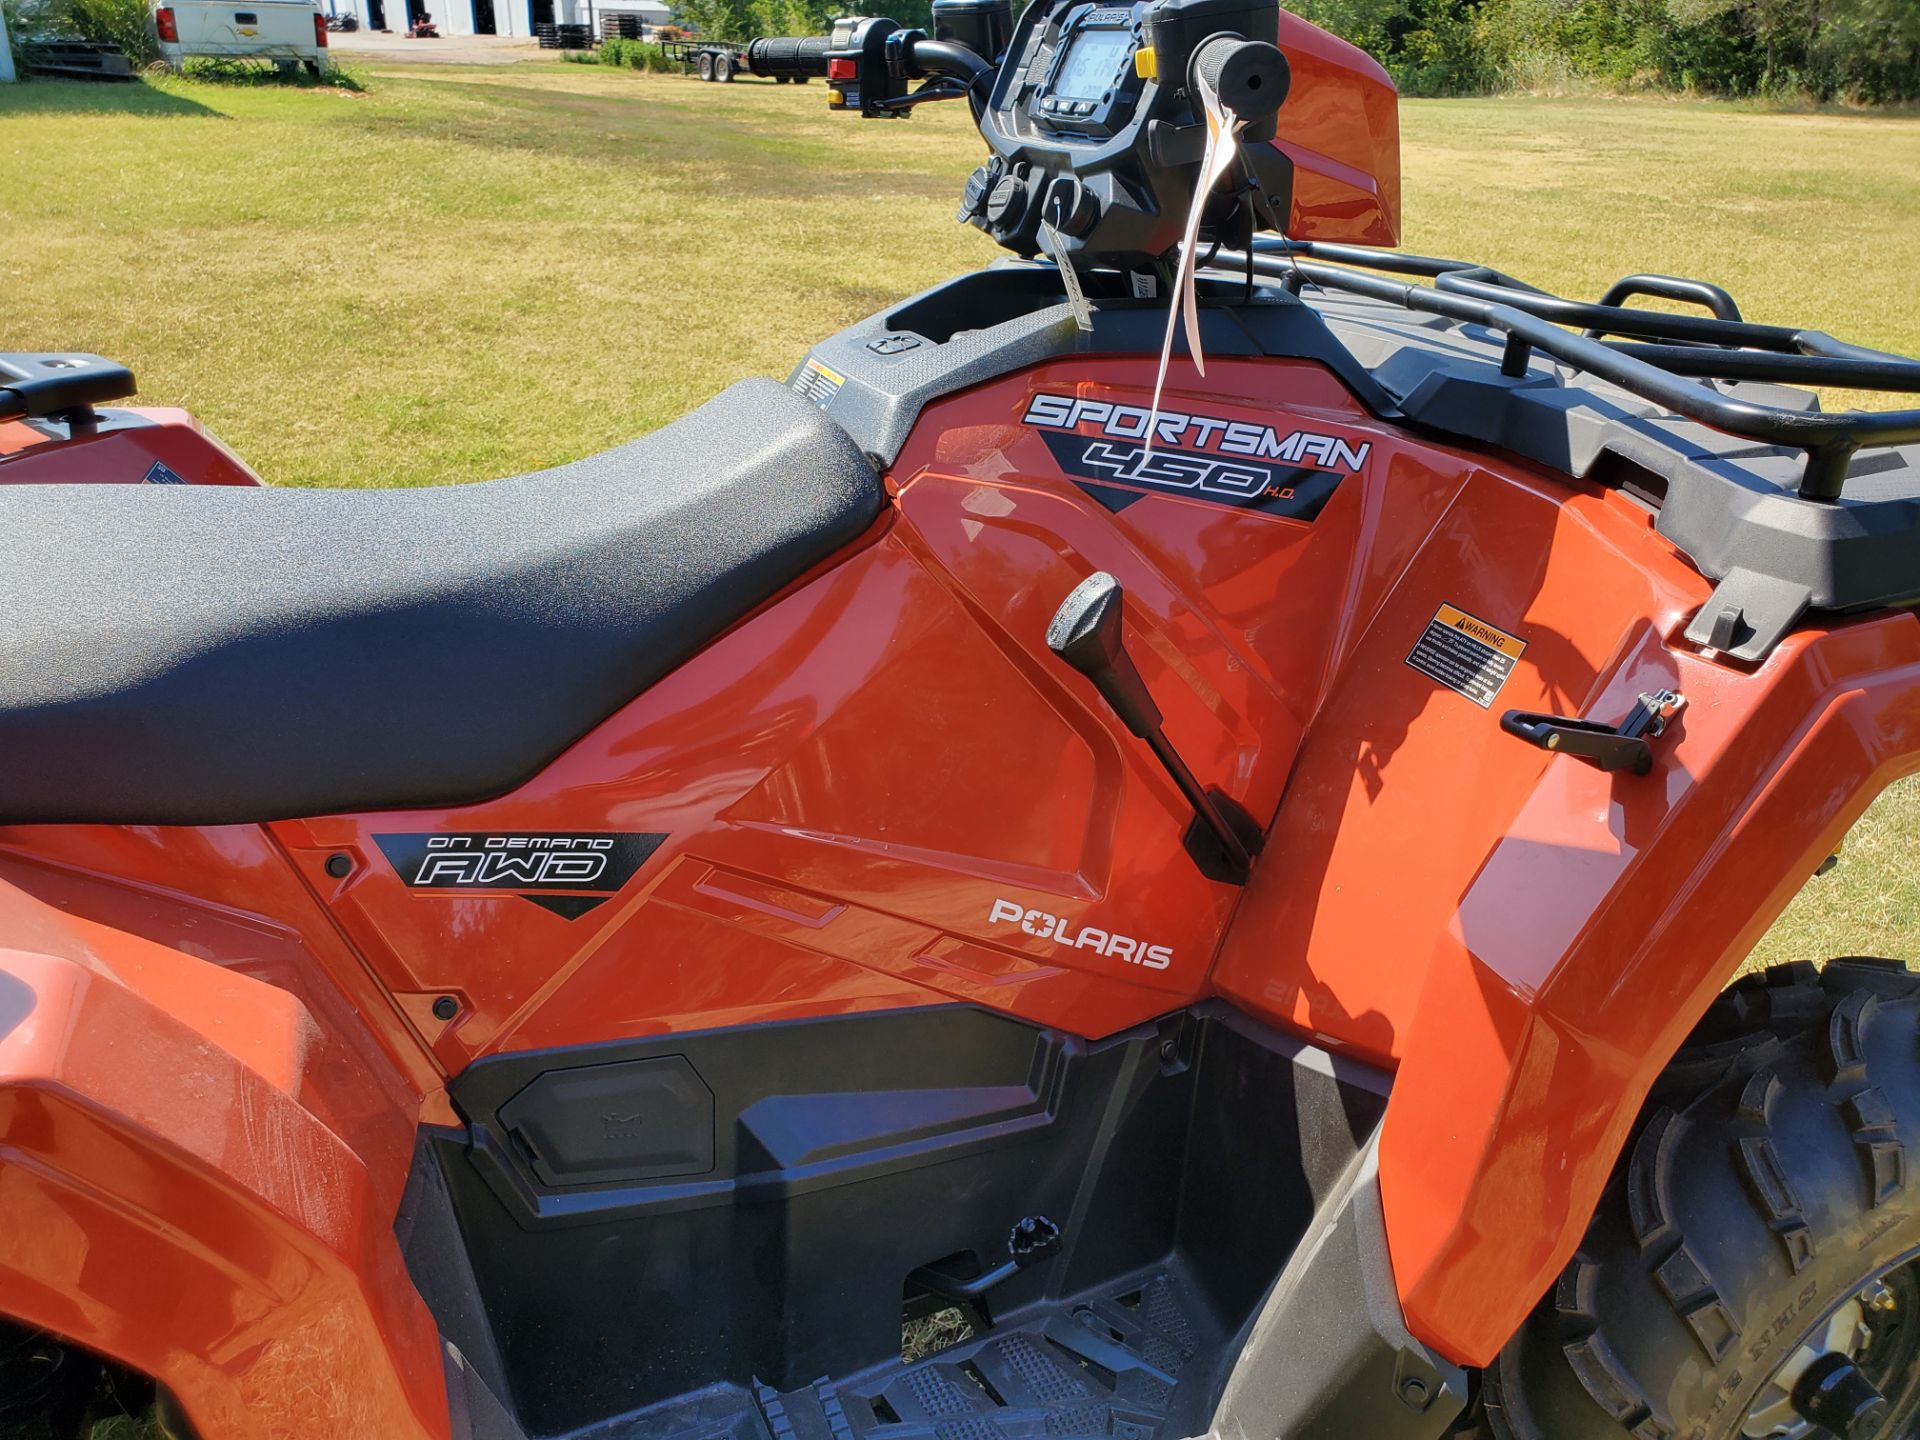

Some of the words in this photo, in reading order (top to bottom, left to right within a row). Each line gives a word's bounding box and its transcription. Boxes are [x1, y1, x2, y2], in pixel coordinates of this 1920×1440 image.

[1024, 394, 1371, 473] SPORTSMAN
[1082, 442, 1271, 499] 450
[1464, 622, 1505, 648] WARNING
[427, 837, 471, 848] ON
[484, 837, 614, 849] DEMAND
[414, 852, 607, 884] AWD
[988, 898, 1174, 970] POLARIS
